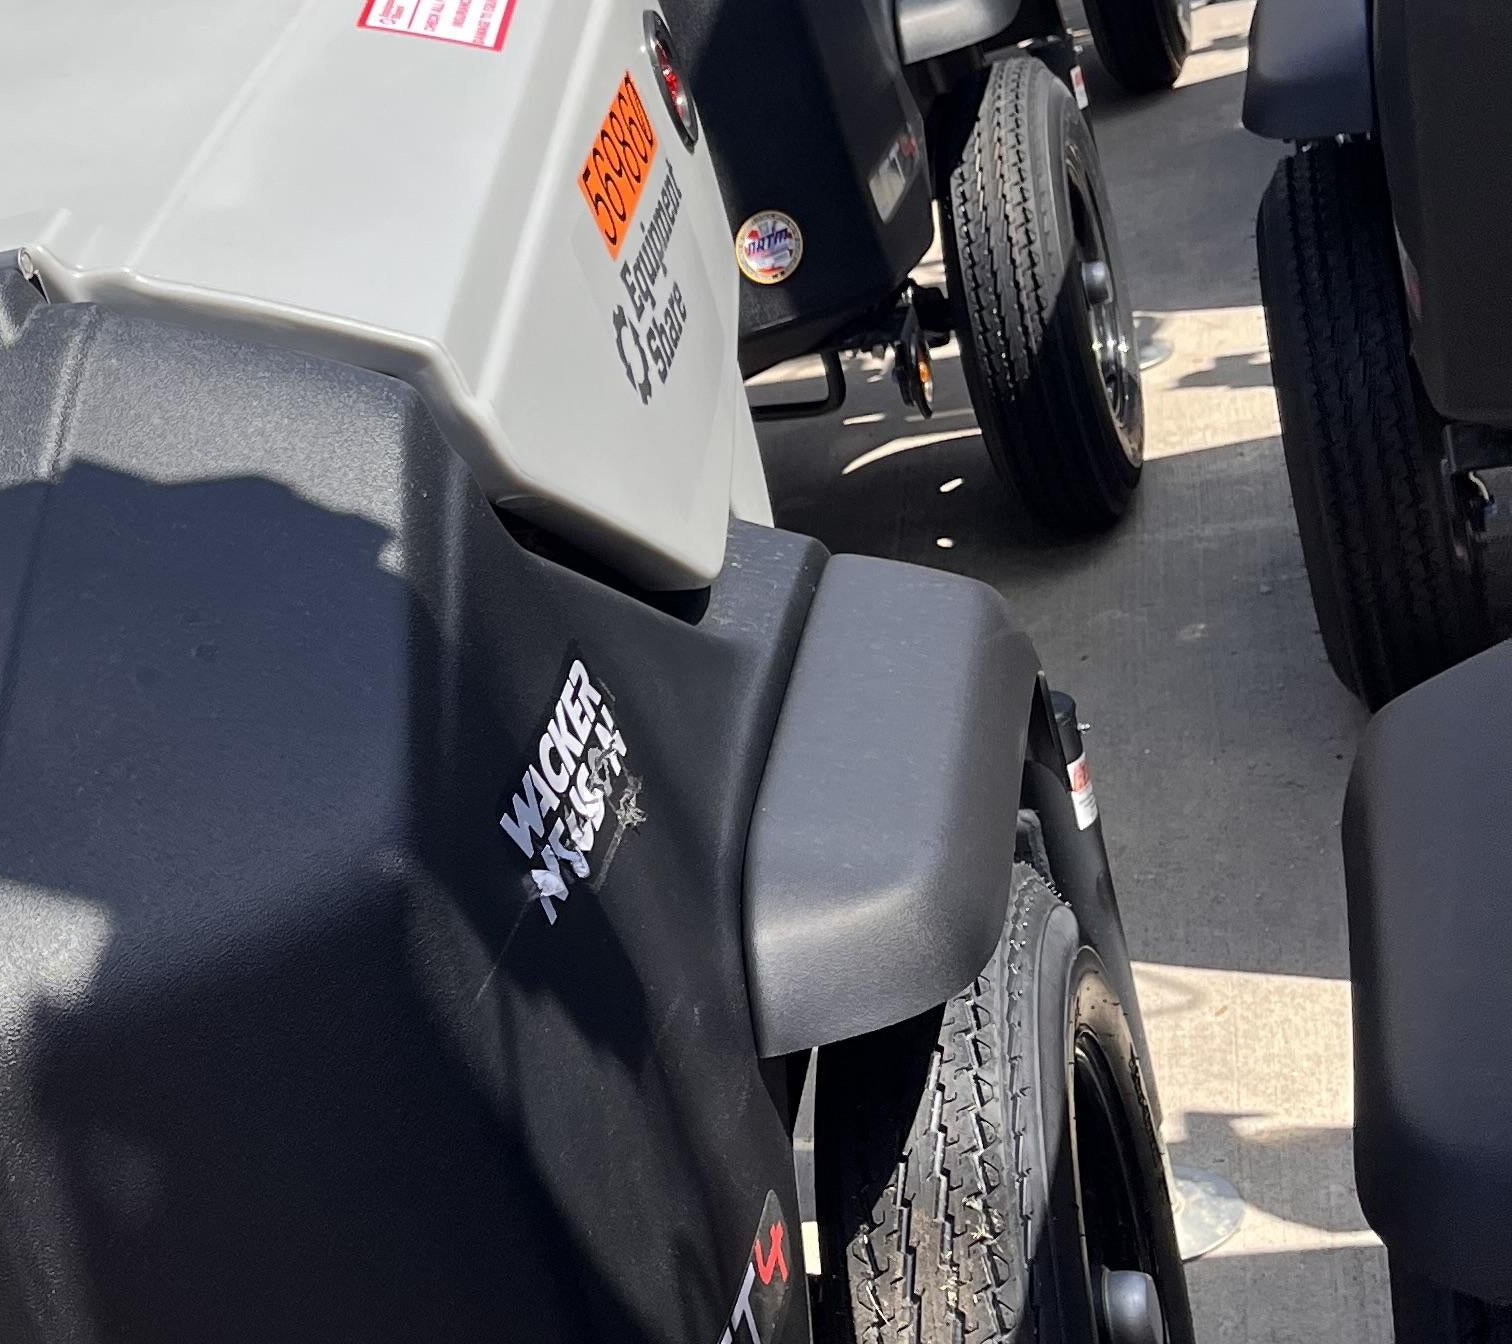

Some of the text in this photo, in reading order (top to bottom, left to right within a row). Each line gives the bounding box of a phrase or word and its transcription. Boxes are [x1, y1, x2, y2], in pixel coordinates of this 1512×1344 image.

[620, 158, 682, 322] Equipment
[646, 281, 686, 384] Share
[500, 659, 602, 859] WACKER
